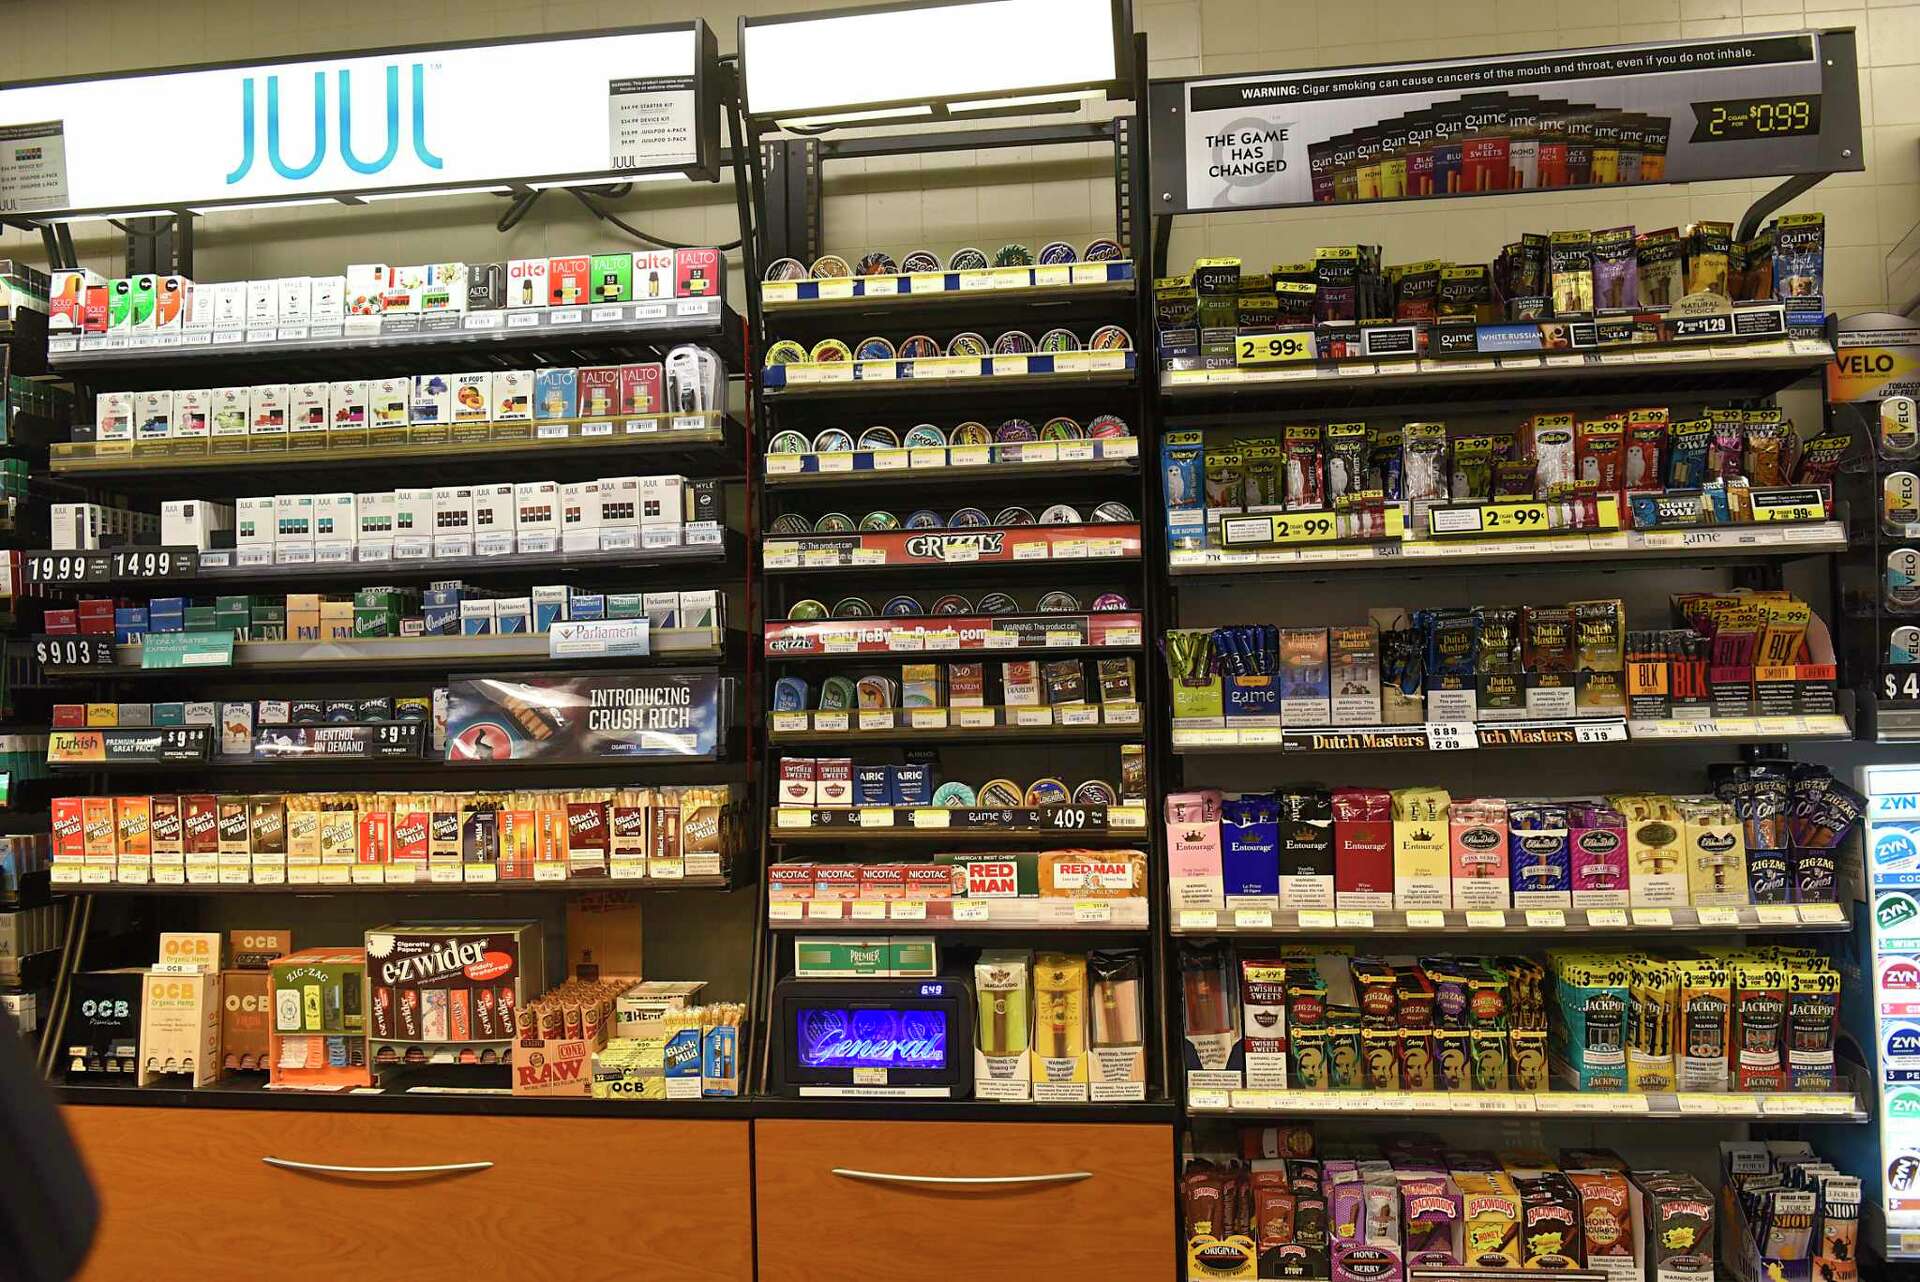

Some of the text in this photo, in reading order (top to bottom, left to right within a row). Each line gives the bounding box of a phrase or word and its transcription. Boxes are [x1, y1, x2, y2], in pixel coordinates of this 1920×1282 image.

[1241, 48, 1755, 99] WARNING: Cigar smoking can cause cancers of the mouth and throat, even if you do not inhale.
[226, 64, 443, 184] JUUL
[1710, 108, 1726, 134] 2
[1206, 130, 1289, 148] THE GAME
[1232, 147, 1263, 160] HAS
[612, 155, 635, 168] JUUL
[1209, 160, 1287, 177] CHANGED
[1678, 321, 1684, 333] 2
[1699, 319, 1725, 332] $1.29
[1440, 333, 1474, 347] game
[1481, 332, 1543, 341] WHITE RUSSIAN
[1242, 342, 1254, 358] 2
[1835, 355, 1894, 373] VELO
[1898, 401, 1908, 432] VELO
[1902, 477, 1912, 509] VELO
[1658, 501, 1696, 510] NIGHT
[1660, 506, 1696, 518] OWL
[1487, 511, 1500, 526] 2
[1277, 522, 1290, 537] 2
[1906, 554, 1916, 586] VELO
[576, 625, 638, 640] Parliament
[769, 639, 813, 651] GRIZZLY
[1908, 631, 1919, 662] VELO
[1639, 664, 1658, 687] BLK
[1673, 662, 1709, 698] BLK
[591, 687, 690, 707] INTRODUCING
[1231, 689, 1275, 704] game
[293, 702, 321, 712] CAMEL
[327, 702, 355, 712] CAMEL
[360, 700, 387, 711] CAMEL
[590, 708, 690, 731] CRUSH RICH
[315, 729, 353, 740] MENTHOL
[1480, 728, 1574, 745] tch Masters
[56, 737, 97, 749] Turkish
[328, 742, 363, 752] DEMAND
[1312, 734, 1424, 750] Dutch Masters
[1880, 794, 1916, 810] ZYN
[615, 809, 639, 824] Black
[968, 811, 999, 822] game
[622, 818, 640, 831] Mild
[685, 817, 716, 833] Black
[694, 826, 717, 840] Mild
[1176, 842, 1215, 852] Entourage
[1231, 842, 1274, 852] Entourage
[1286, 840, 1328, 850] Entourage
[1344, 840, 1385, 851] Entourage
[1402, 841, 1443, 851] Entourage
[1878, 842, 1908, 860] ZYN
[969, 864, 1014, 878] RED
[1059, 864, 1126, 875] RED MAN
[1751, 859, 1786, 872] ZIG-ZAG
[1799, 859, 1834, 871] ZIG-ZAG
[772, 871, 809, 879] NICOTAC
[817, 870, 855, 879] NICOTAC
[862, 870, 901, 879] NICOTAC
[908, 870, 947, 879] NICOTAC
[970, 880, 1014, 894] MAN
[1880, 900, 1906, 920] ZYN
[165, 939, 209, 955] OCB
[244, 936, 278, 948] OCB
[286, 967, 329, 983] ZIG-ZAG
[1887, 970, 1918, 984] ZYN
[152, 984, 195, 998] OCB
[1250, 985, 1282, 993] SWISHER
[1251, 992, 1282, 1000] SWEETS
[82, 1000, 129, 1017] OCB
[1582, 1000, 1626, 1013] JACKPOT
[1684, 1000, 1728, 1013] JACKPOT
[1739, 1000, 1783, 1013] JACKPOT
[1789, 1004, 1834, 1016] JACKPOT
[666, 1042, 697, 1057] Black
[801, 1028, 944, 1065] General
[675, 1049, 698, 1064] Mild
[517, 1060, 583, 1085] RAW
[612, 1083, 644, 1092] OCB
[1410, 1197, 1456, 1220] BACKWOODS
[1469, 1198, 1514, 1220] BACKWOODS
[1661, 1201, 1710, 1221] BACKWOODS
[1526, 1206, 1574, 1227] BACKWOODS
[1586, 1218, 1618, 1226] HONEY
[1585, 1226, 1621, 1234] BOURBON
[1472, 1234, 1479, 1244] 5
[1204, 1247, 1240, 1256] ORIGINAL
[1353, 1251, 1380, 1260] HONEY
[1284, 1267, 1303, 1275] STOUT
